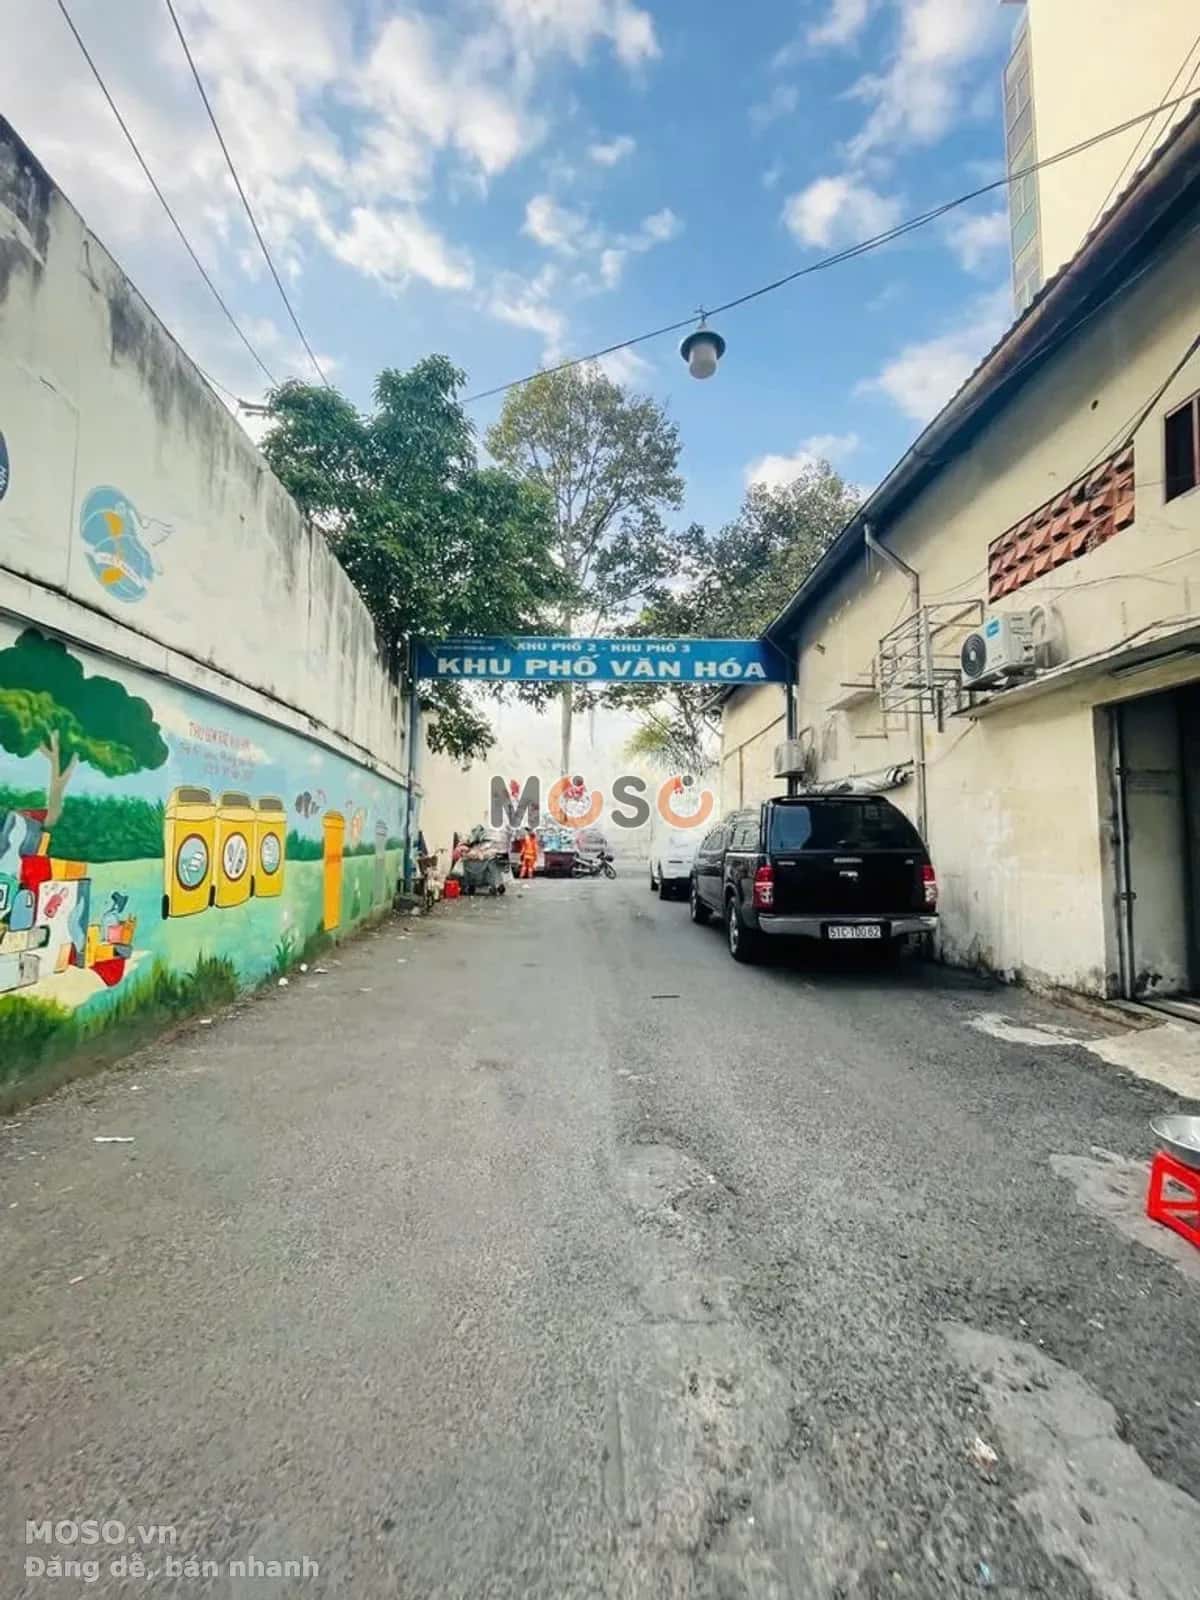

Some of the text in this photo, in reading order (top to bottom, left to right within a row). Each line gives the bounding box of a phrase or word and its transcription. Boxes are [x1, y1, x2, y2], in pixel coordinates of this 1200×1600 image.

[517, 642, 547, 651] KHU
[587, 642, 597, 652] 2
[611, 643, 641, 652] KHU
[681, 644, 690, 653] 3
[437, 654, 767, 678] KHU PHỐ VĂN HÓA
